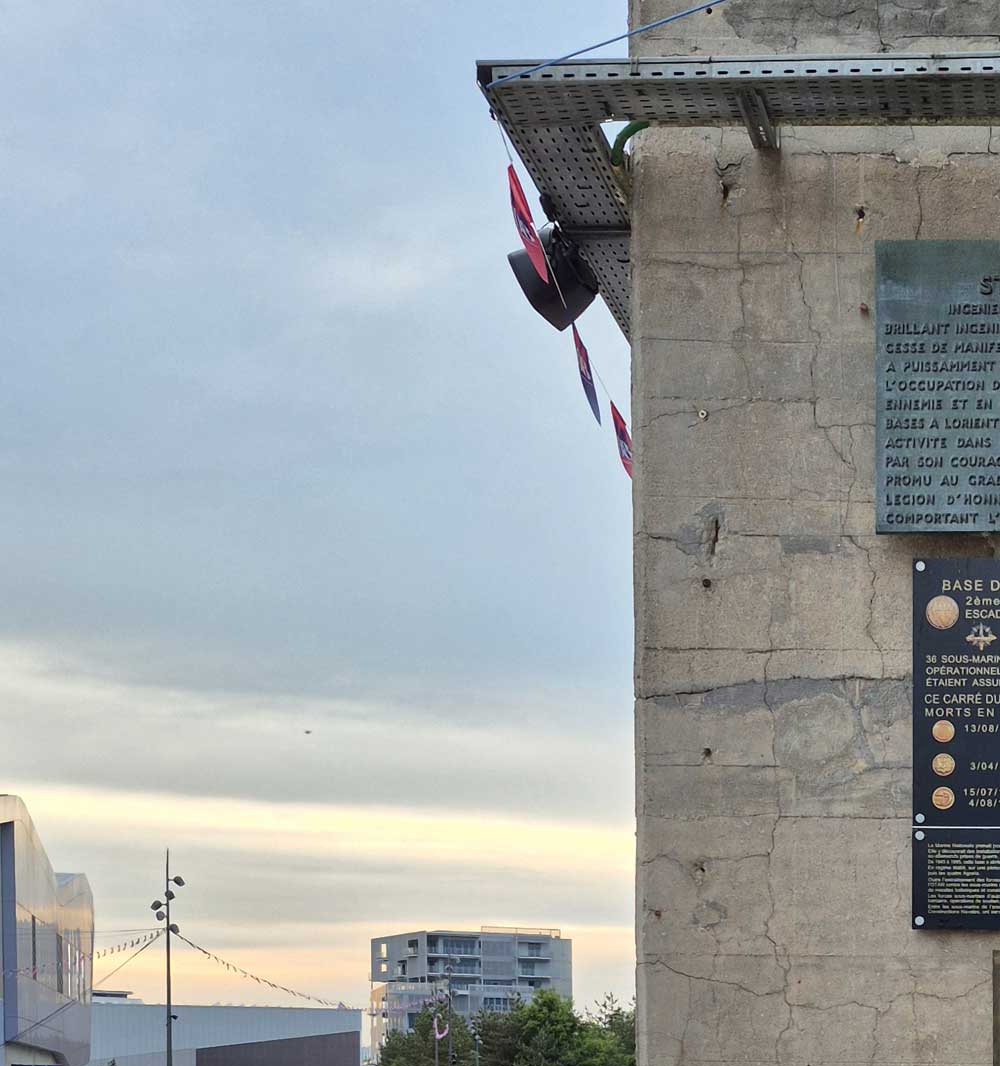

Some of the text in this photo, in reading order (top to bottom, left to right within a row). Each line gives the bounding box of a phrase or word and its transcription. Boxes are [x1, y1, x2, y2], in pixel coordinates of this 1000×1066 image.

[886, 399, 943, 411] ENNEMIE
[951, 399, 968, 410] ET
[976, 399, 992, 410] EN
[886, 474, 932, 487] PROMU
[938, 475, 958, 487] AU
[886, 512, 982, 524] COMPORTANT
[942, 579, 983, 592] BASE
[966, 596, 1000, 605] 2ème
[925, 694, 940, 704] CE
[943, 693, 982, 704] CARRÉ
[986, 694, 1000, 704] DU
[925, 708, 971, 717] MORTS
[978, 708, 994, 717] EN
